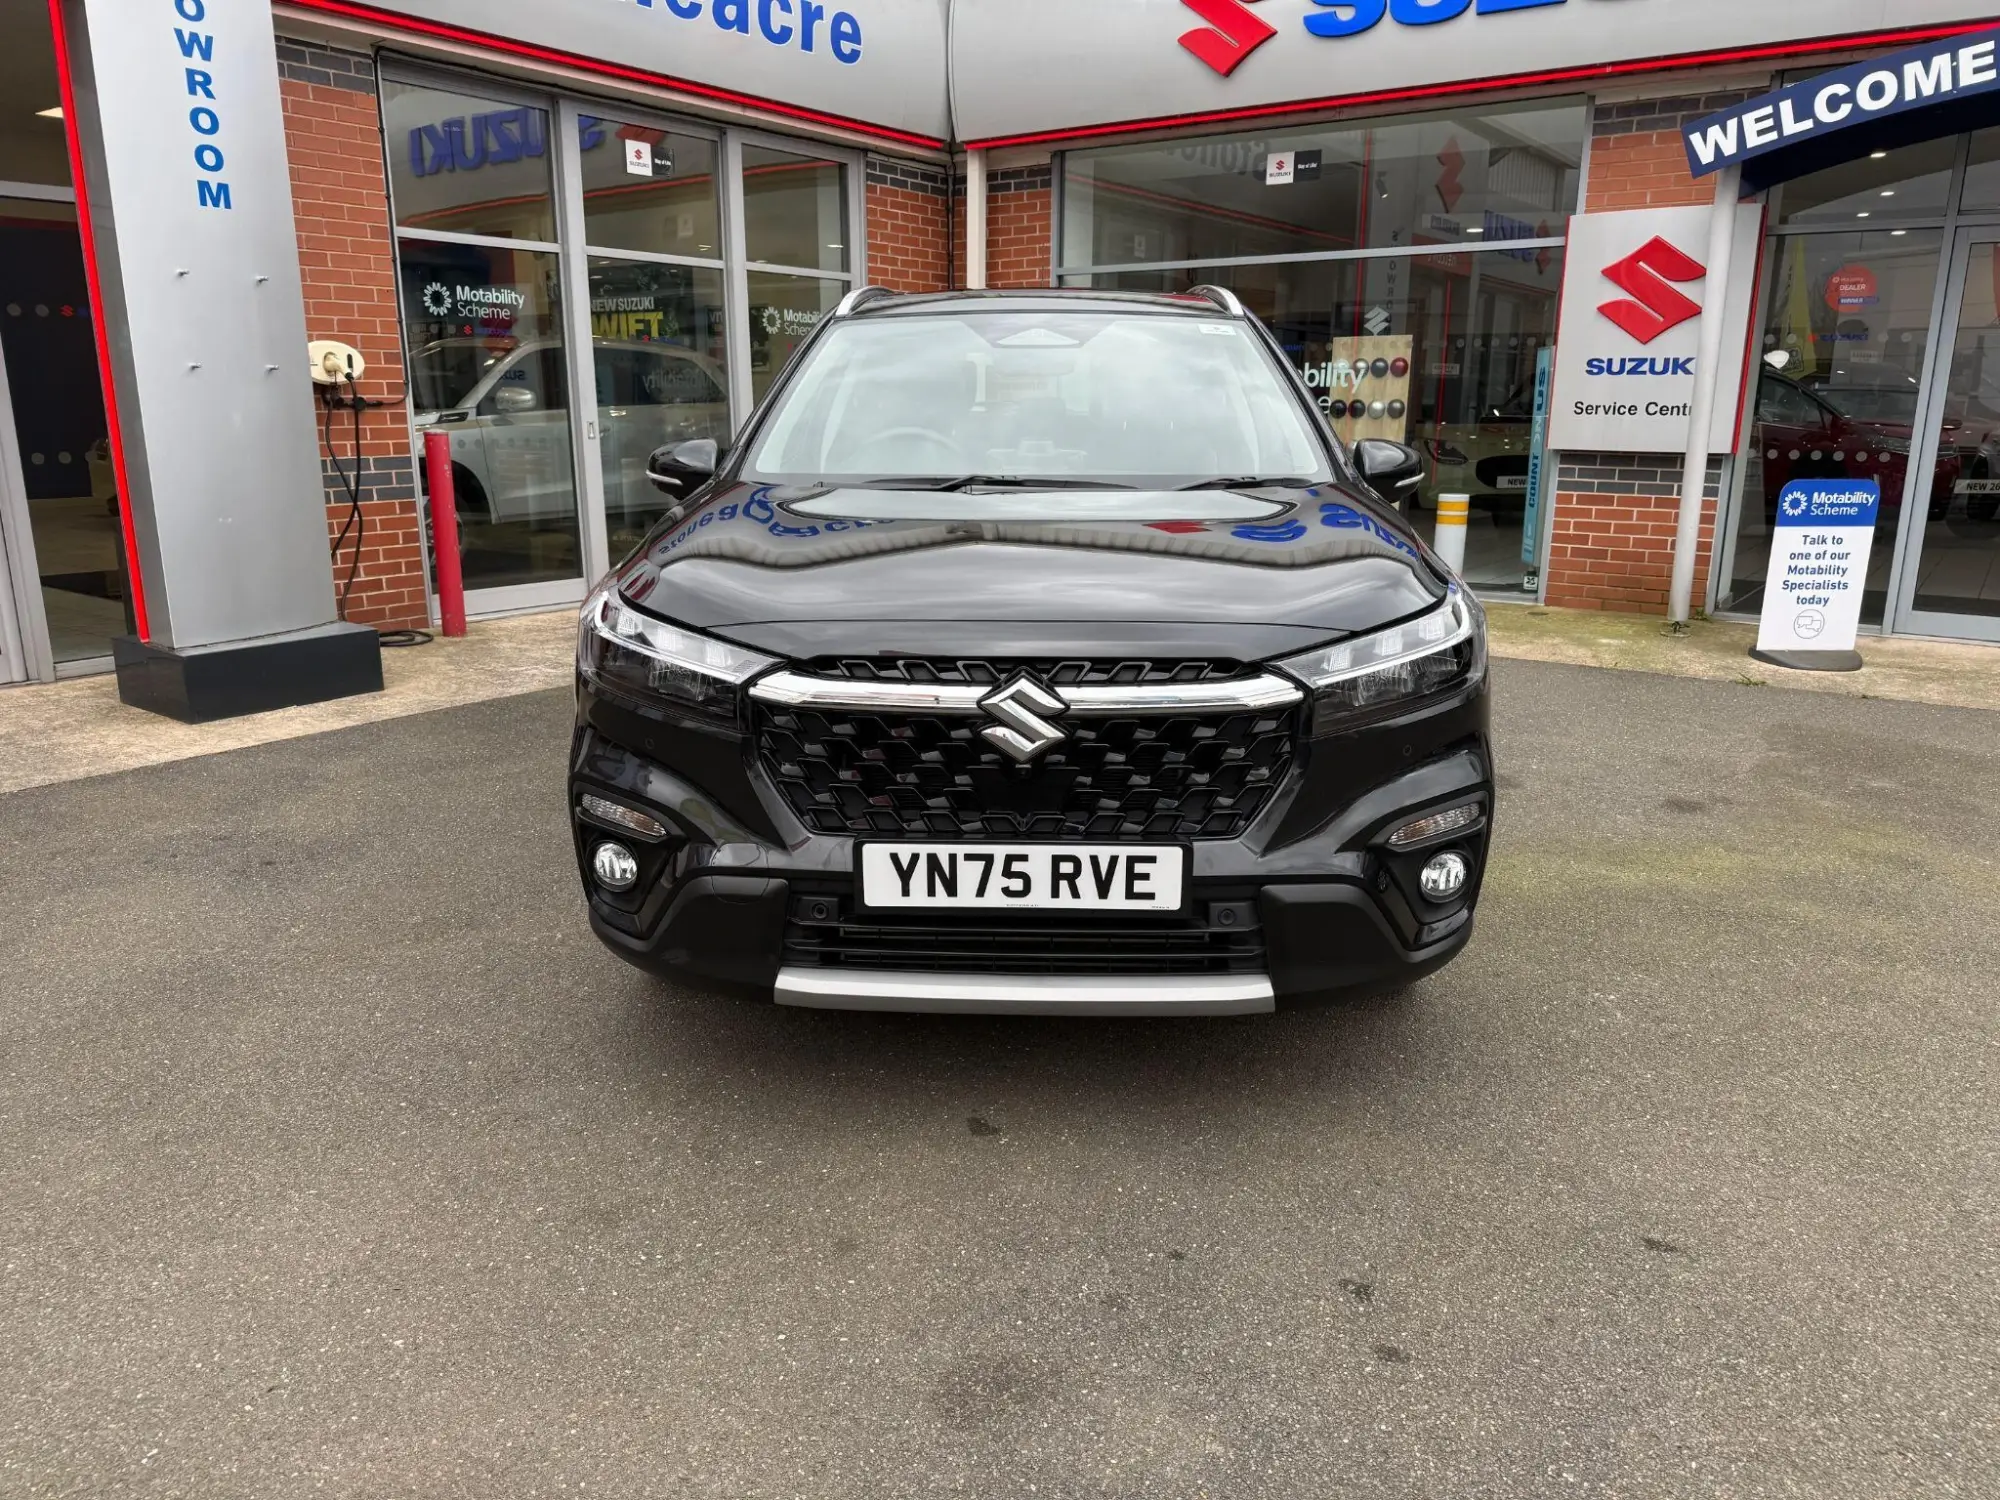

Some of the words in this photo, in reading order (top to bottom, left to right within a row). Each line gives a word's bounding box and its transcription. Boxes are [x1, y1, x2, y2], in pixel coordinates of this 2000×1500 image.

[1688, 40, 1997, 165] WELCOME
[456, 285, 525, 309] Motability
[618, 296, 655, 311] SUZUKI
[457, 302, 511, 320] Scheme
[1585, 357, 1696, 376] SUZUK
[1573, 401, 1638, 416] Service
[1528, 453, 1540, 508] COUNT
[1536, 366, 1546, 412] US
[1507, 478, 1526, 486] NEW
[1966, 482, 1988, 491] NEW
[1812, 491, 1876, 506] Motability
[1810, 504, 1858, 516] Scheme
[1802, 535, 1828, 546] Talk
[1832, 535, 1844, 545] to
[1789, 552, 1812, 561] one
[1815, 550, 1828, 561] of
[1830, 552, 1851, 561] our
[1787, 565, 1849, 578] Motability
[1781, 580, 1849, 593] Specialists
[1796, 595, 1830, 607] today
[889, 852, 1032, 898] YN75
[1050, 854, 1158, 900] RVE
